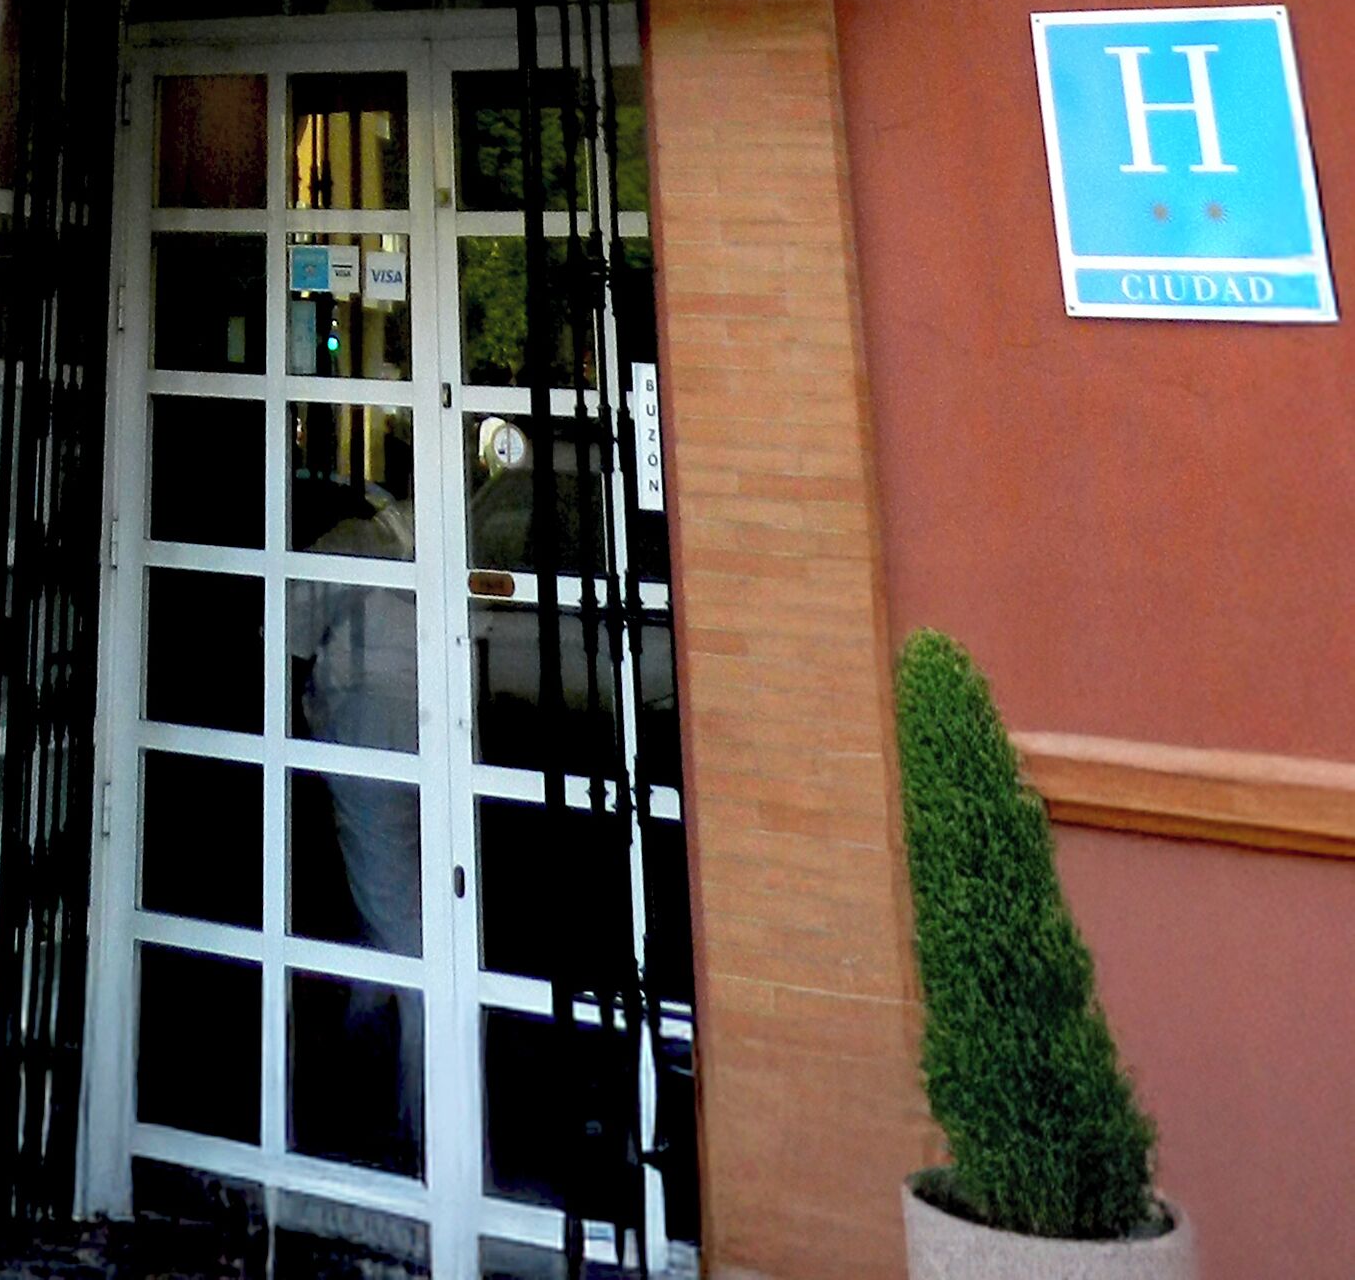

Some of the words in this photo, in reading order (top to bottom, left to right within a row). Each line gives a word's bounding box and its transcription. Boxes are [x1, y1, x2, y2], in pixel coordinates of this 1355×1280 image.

[1104, 44, 1239, 173] H
[371, 268, 403, 284] VISA
[1121, 275, 1275, 303] CIUDAD
